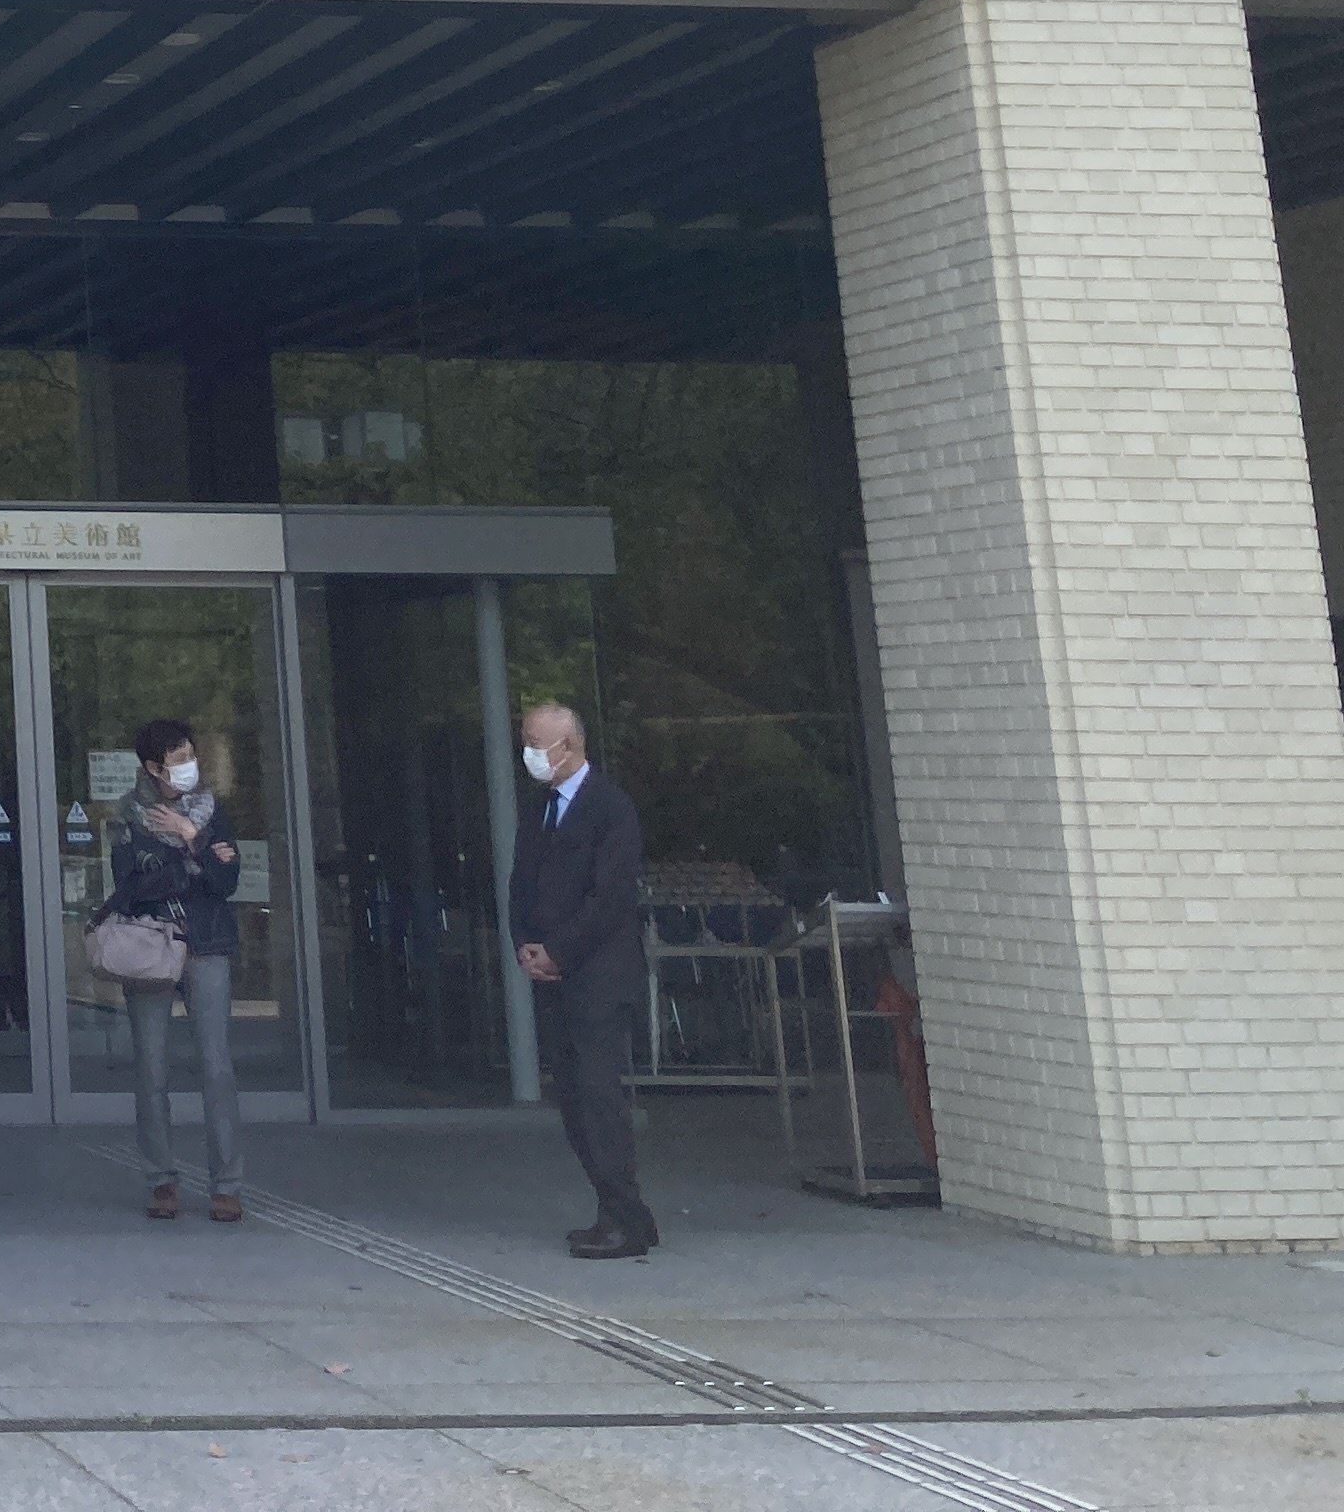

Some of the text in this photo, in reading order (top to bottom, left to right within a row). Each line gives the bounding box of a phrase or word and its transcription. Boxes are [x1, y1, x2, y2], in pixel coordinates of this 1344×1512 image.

[56, 551, 100, 561] MUSEUM
[105, 551, 117, 561] OF
[121, 551, 142, 561] ART
